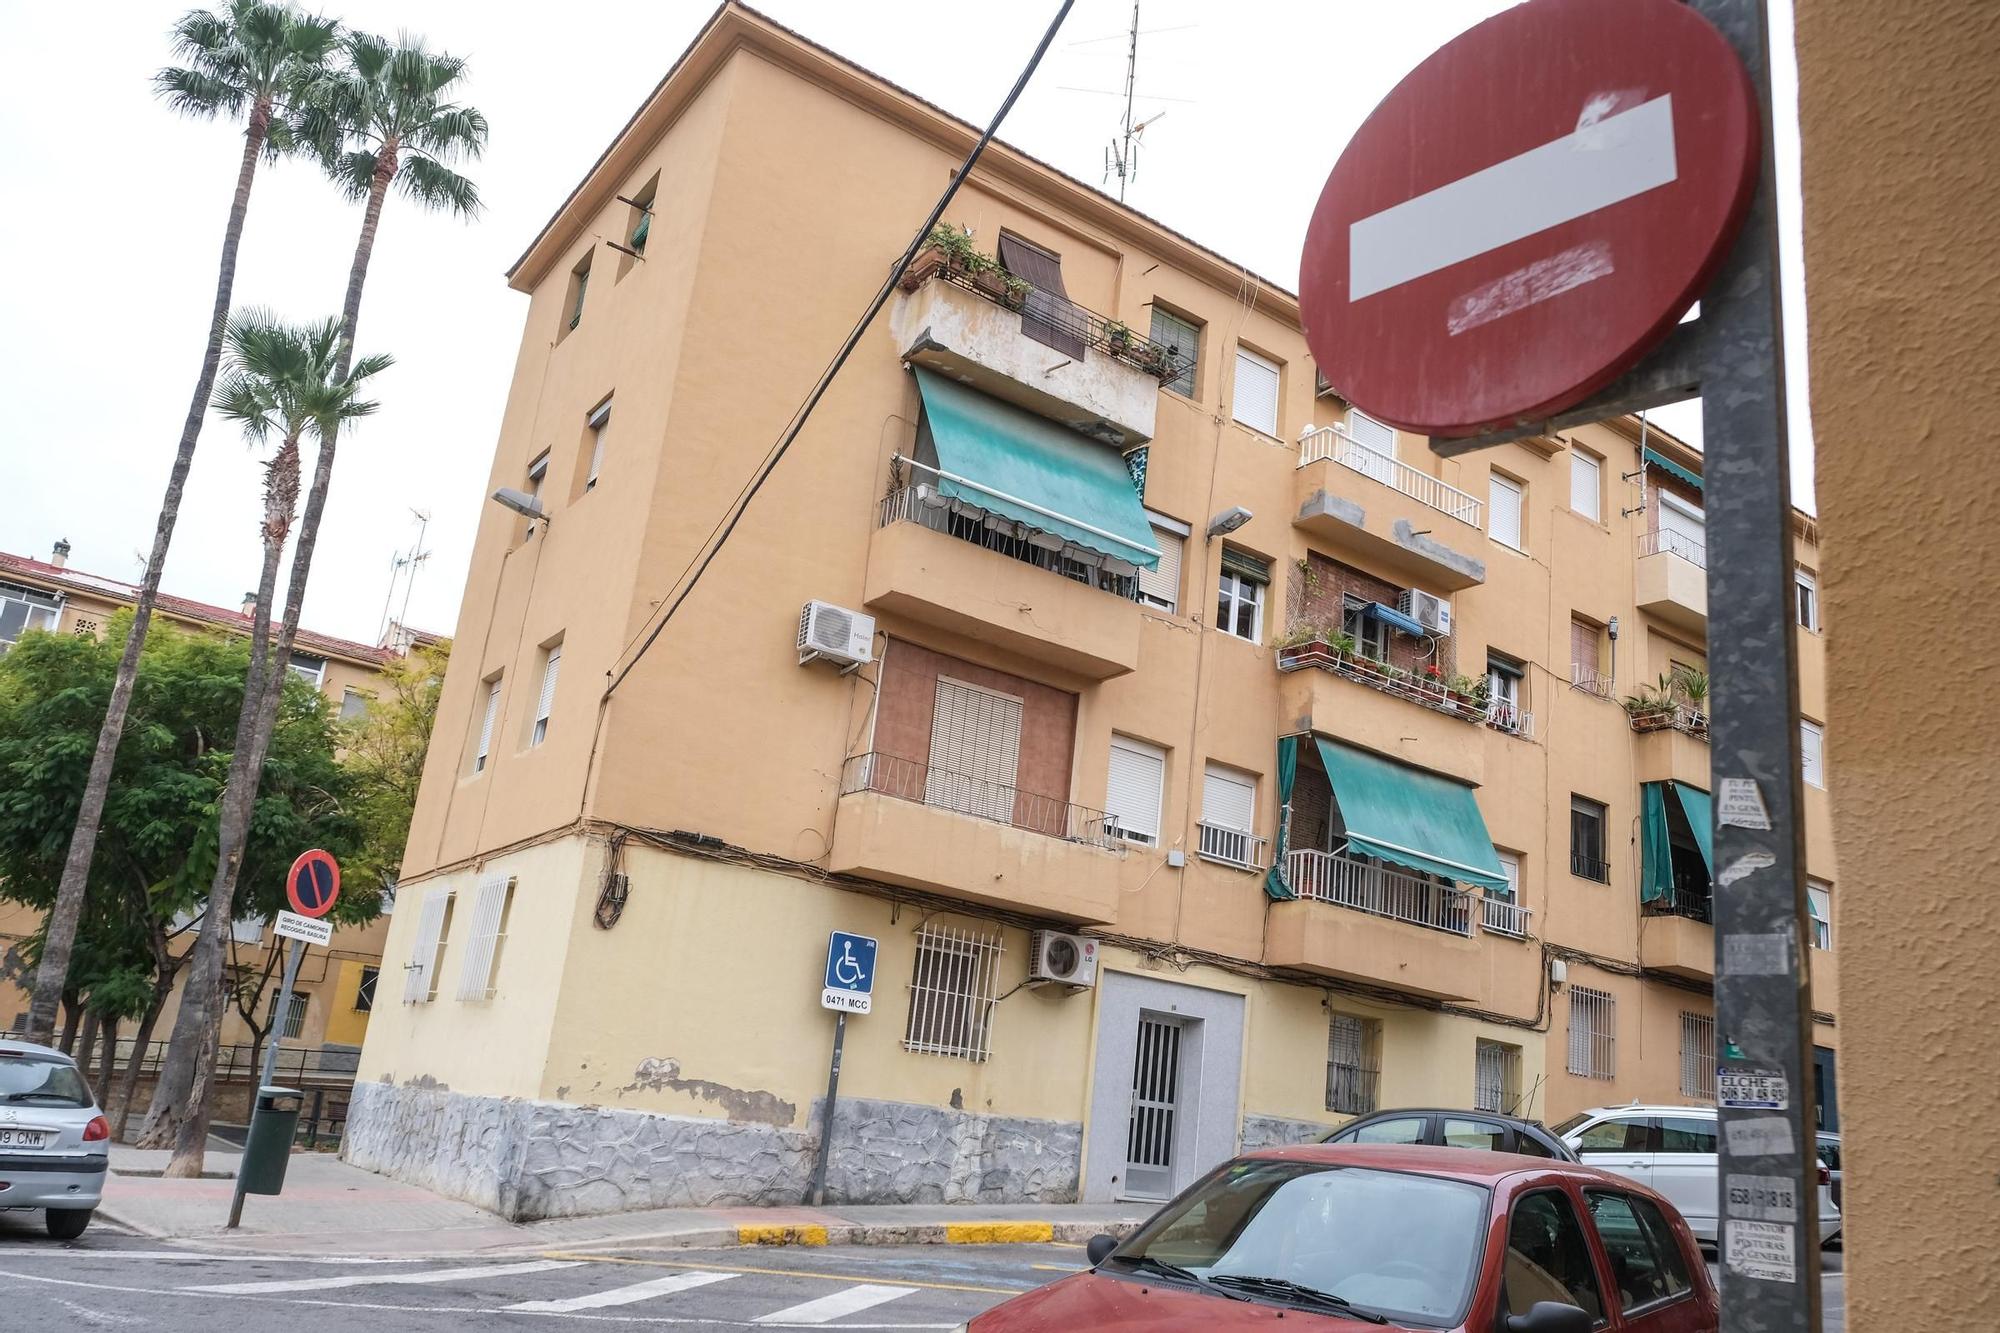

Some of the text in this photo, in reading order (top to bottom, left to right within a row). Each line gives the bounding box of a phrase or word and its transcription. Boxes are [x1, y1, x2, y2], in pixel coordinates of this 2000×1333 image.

[281, 924, 326, 939] RECOGIDA BASURA
[282, 917, 295, 925] GIRO
[303, 922, 328, 933] CAMIONES
[826, 995, 868, 1009] 0471 MCC
[1721, 1077, 1769, 1088] ELCHE
[18, 1132, 41, 1144] CNW
[1748, 1223, 1786, 1234] PINTOR
